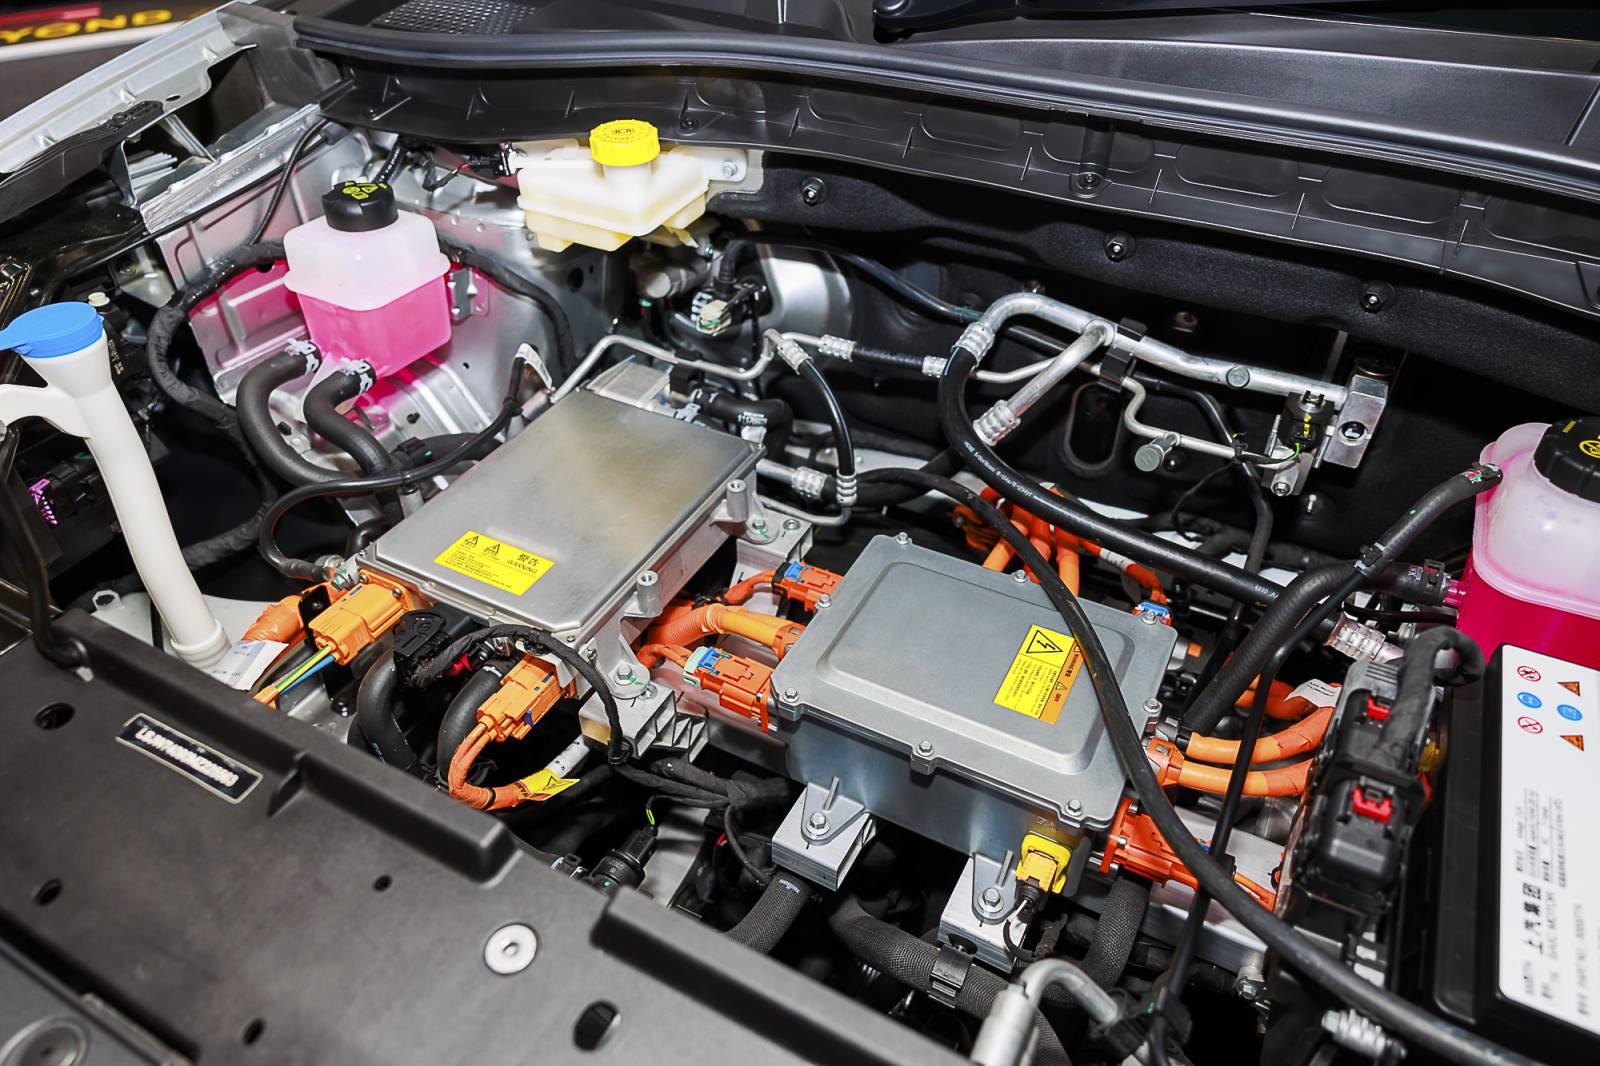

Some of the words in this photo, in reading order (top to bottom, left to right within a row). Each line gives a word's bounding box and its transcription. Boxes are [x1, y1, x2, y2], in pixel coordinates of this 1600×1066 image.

[506, 559, 539, 574] WARNING
[1522, 882, 1544, 956] 上汽集团
